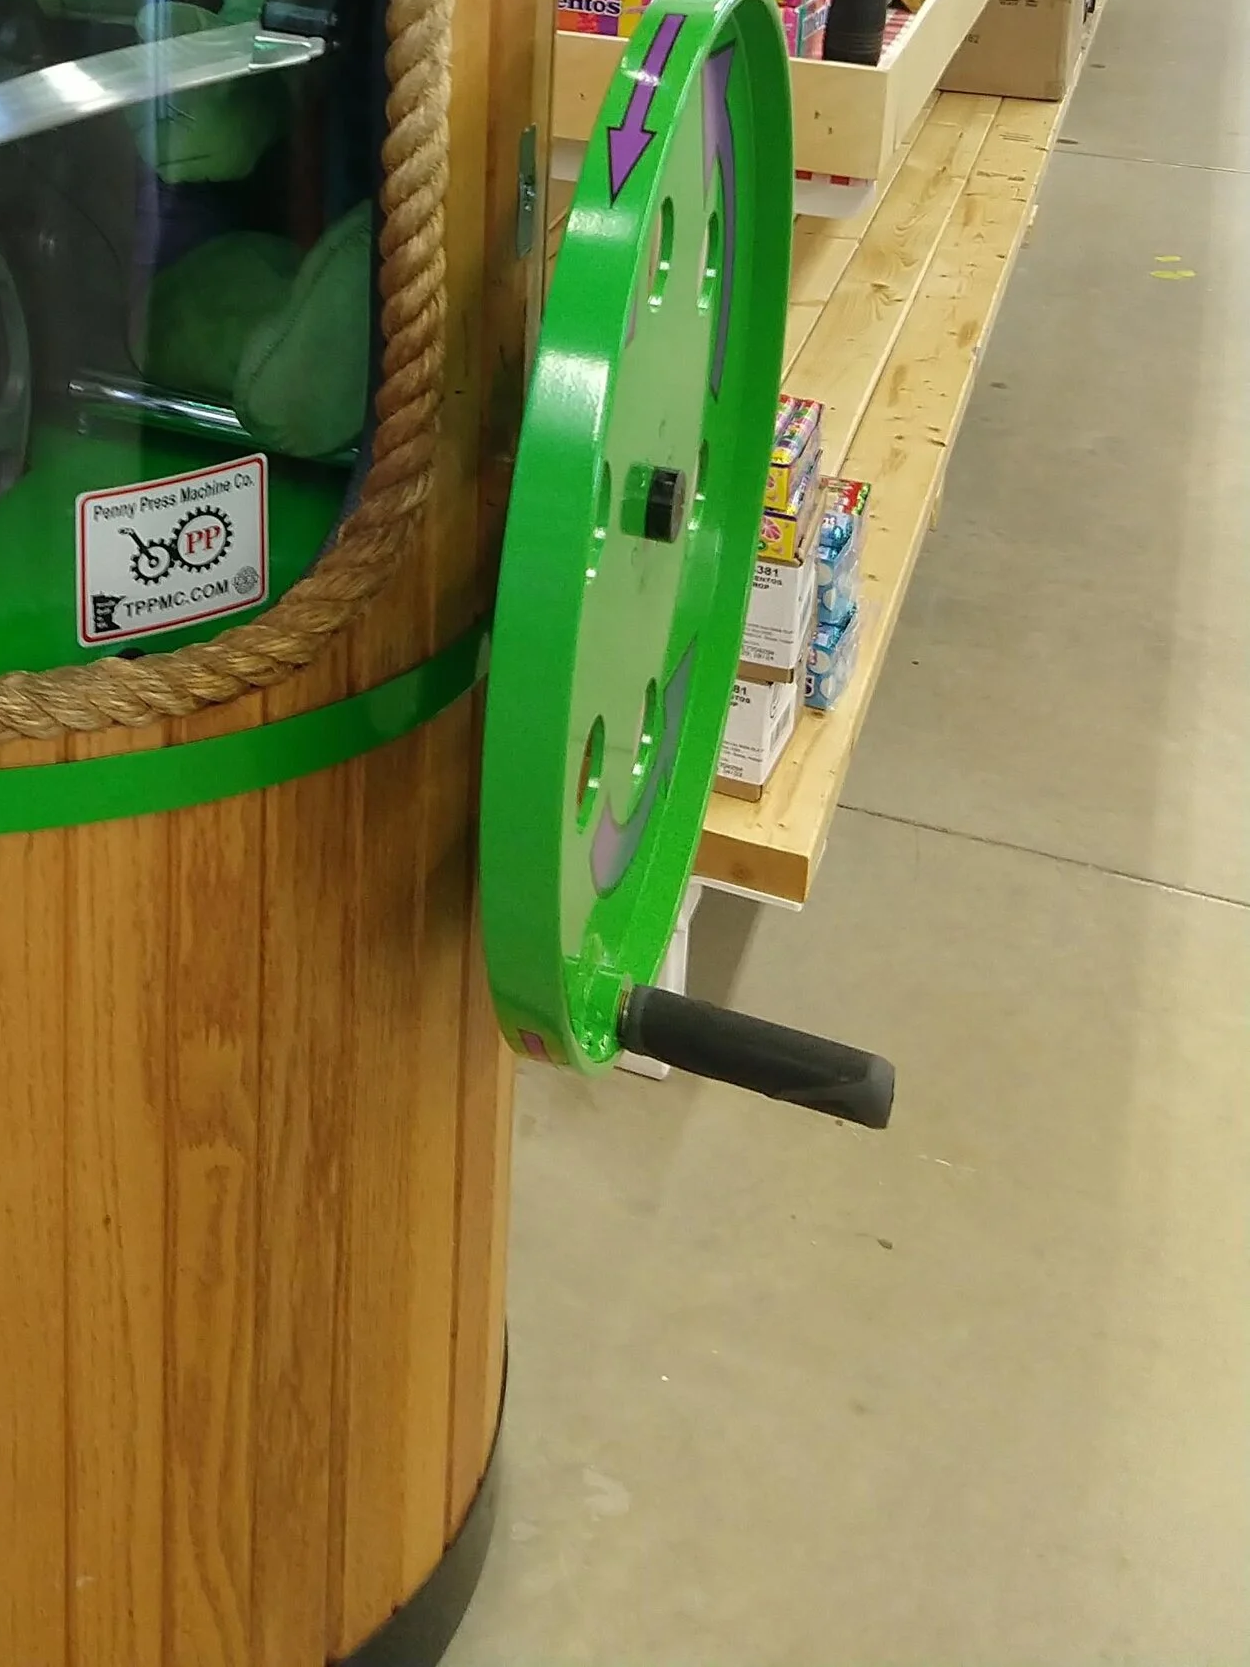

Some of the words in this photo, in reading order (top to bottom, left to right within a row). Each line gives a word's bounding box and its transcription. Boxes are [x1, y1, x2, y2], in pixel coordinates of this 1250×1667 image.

[93, 501, 137, 523] Penny
[139, 493, 177, 513] Press
[180, 479, 232, 504] Machine
[233, 472, 256, 490] Co.
[184, 524, 222, 556] PP
[754, 575, 783, 587] ENTOS
[755, 565, 779, 578] 381
[752, 581, 770, 591] ROP
[123, 580, 229, 619] TPPMC.COM
